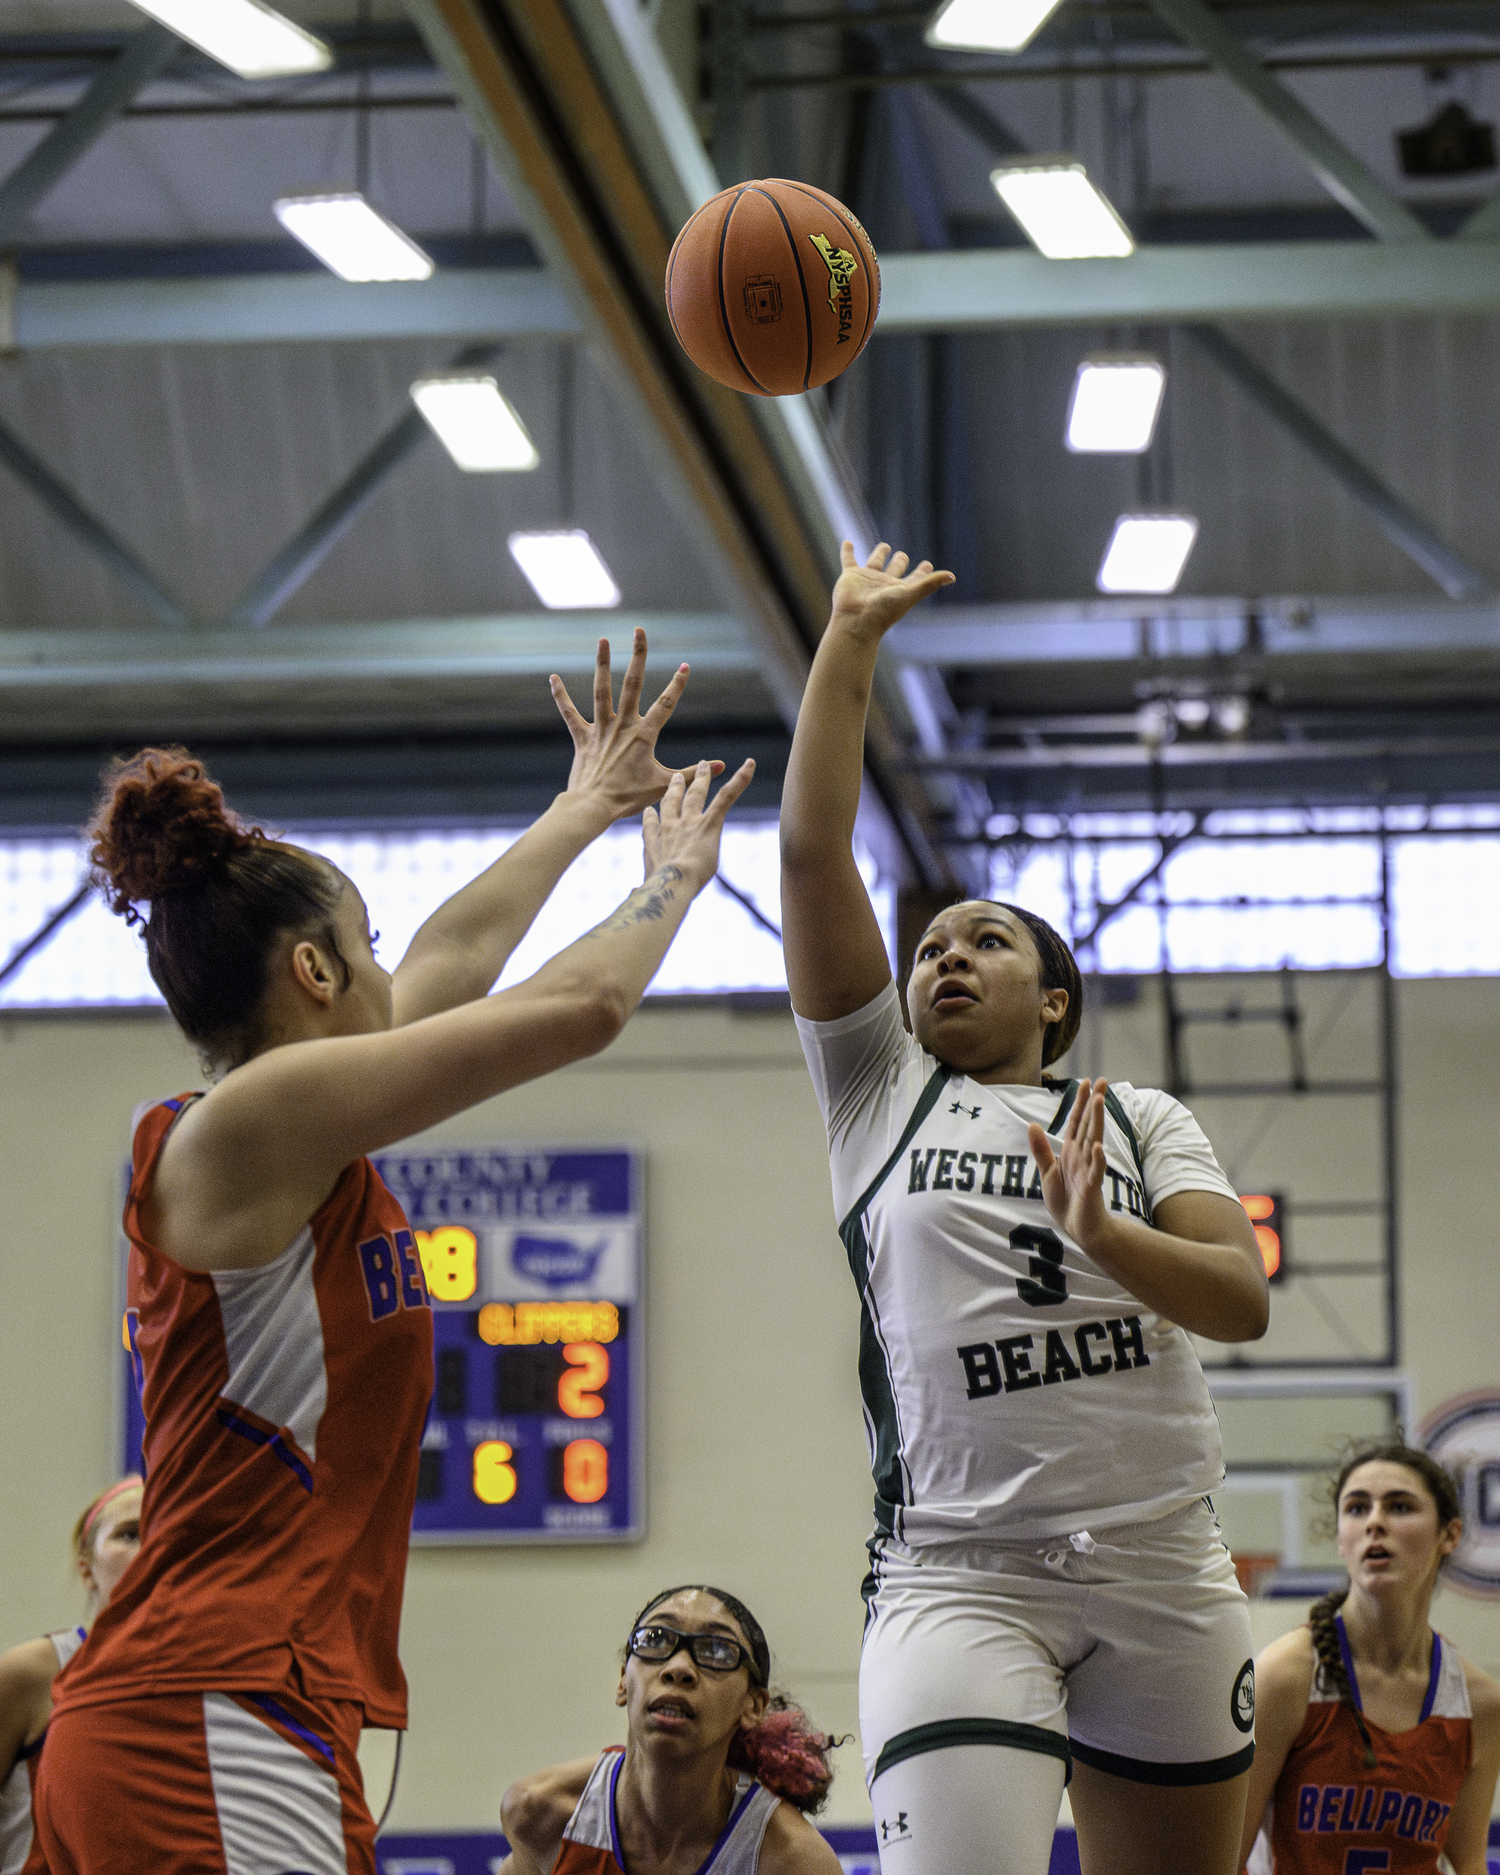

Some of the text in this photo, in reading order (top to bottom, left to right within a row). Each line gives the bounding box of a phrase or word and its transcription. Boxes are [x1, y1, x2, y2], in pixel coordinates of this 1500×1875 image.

[825, 247, 853, 345] NYSPHSAA
[356, 1227, 432, 1323] BE
[1009, 1223, 1069, 1307] 3
[558, 1342, 609, 1418] 2
[957, 1315, 1150, 1400] BEACH
[473, 1440, 517, 1504] 6
[563, 1438, 608, 1503] 0
[1297, 1784, 1450, 1846] BELLPORT
